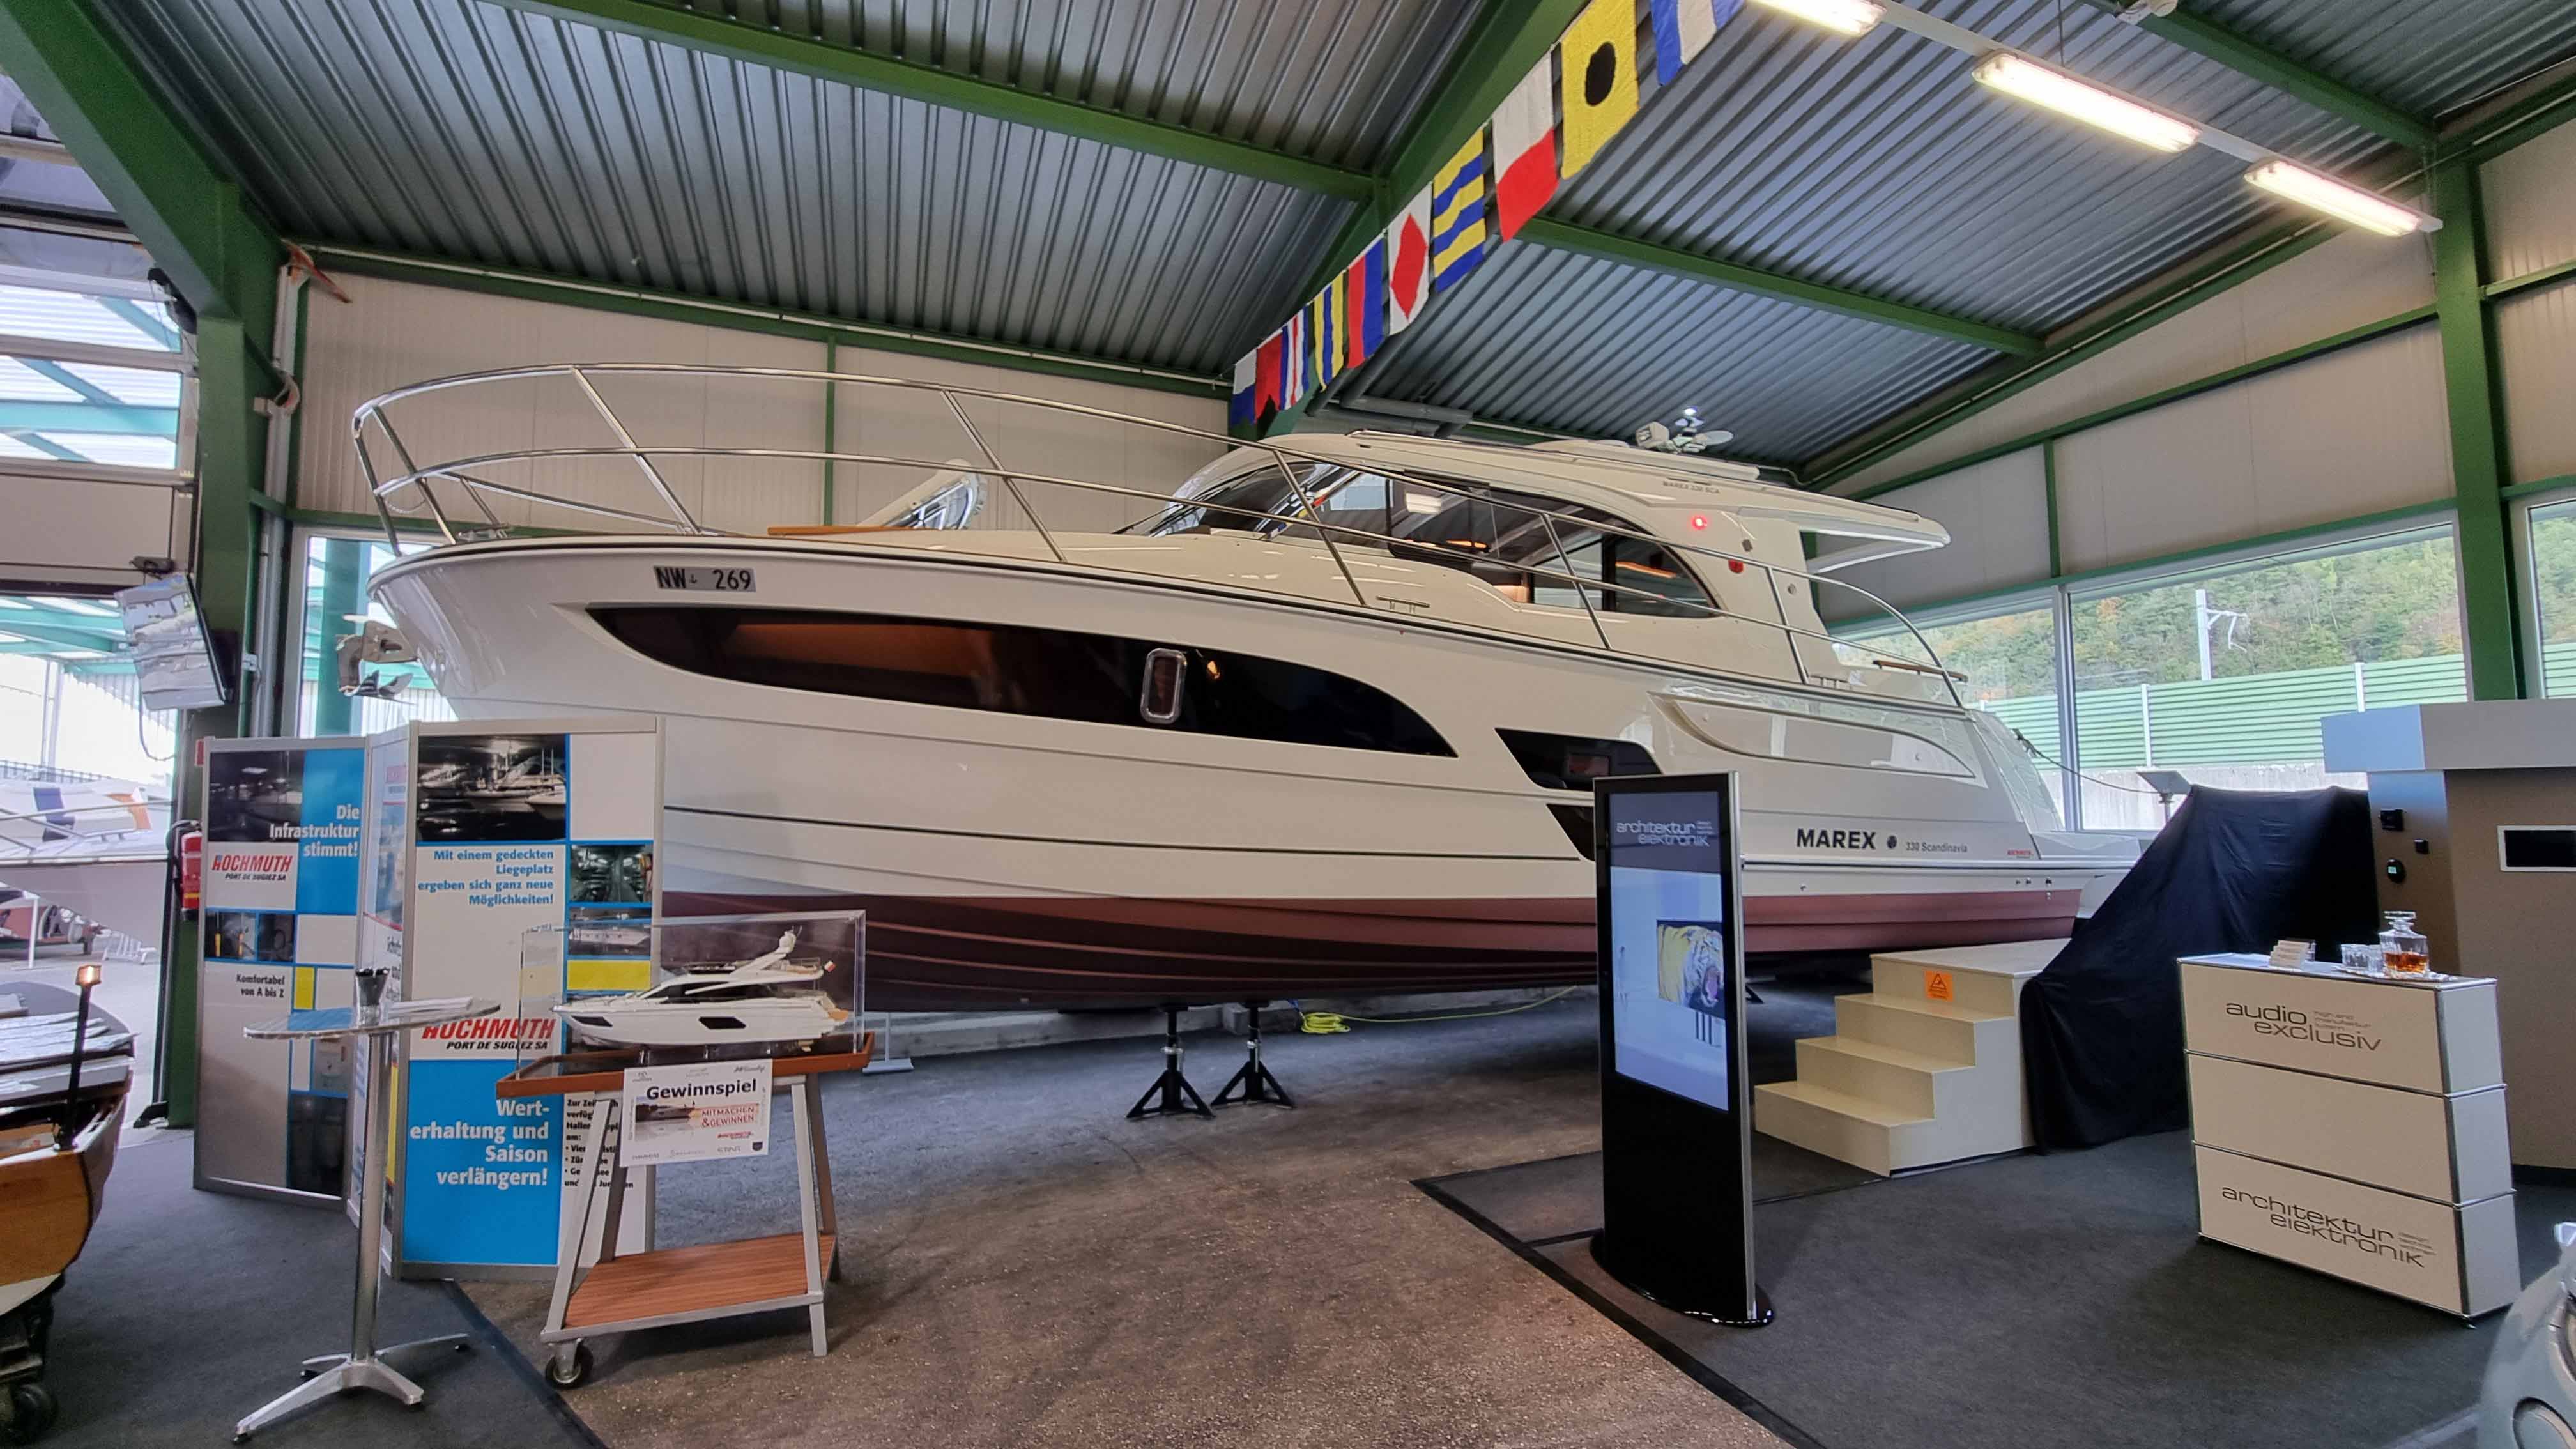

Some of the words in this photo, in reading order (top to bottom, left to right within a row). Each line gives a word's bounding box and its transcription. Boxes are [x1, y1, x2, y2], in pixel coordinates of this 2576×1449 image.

[656, 567, 686, 588] NW
[712, 569, 751, 590] 269
[336, 804, 359, 820] Die
[269, 822, 359, 839] Infrastruktur
[1616, 820, 1696, 834] architektur
[1637, 833, 1710, 847] elektronik
[1797, 828, 1876, 850] MAREX
[1905, 841, 1920, 852] 330
[1921, 841, 1968, 854] Scandinavia
[303, 841, 358, 857] stimmt!
[434, 849, 453, 859] Mit
[457, 850, 492, 859] einem
[496, 849, 554, 862] gedeckten
[211, 854, 293, 872] HOCHMUTH
[496, 864, 554, 877] Liegeplatz
[418, 880, 465, 893] ergeben
[470, 880, 492, 890] sich
[495, 882, 522, 893] ganz
[526, 882, 554, 890] neue
[469, 893, 554, 907] Möglichkeiten!
[236, 974, 286, 986] Komfortabel
[241, 988, 255, 997] von
[257, 988, 263, 997] A
[265, 988, 277, 997] bis
[279, 989, 285, 997] Z
[2225, 1001, 2308, 1025] audio
[421, 1018, 556, 1039] HOCHMUTH
[2253, 1021, 2382, 1052] exclusiv
[447, 1040, 475, 1050] PORT
[477, 1041, 491, 1050] DE
[535, 1041, 548, 1050] SA
[647, 1078, 757, 1100] Gewinnspiel
[496, 1100, 550, 1117] Wert-
[702, 1106, 755, 1117] MITMACHEN
[410, 1121, 506, 1143] erhaltung
[512, 1122, 549, 1139] und
[485, 1144, 548, 1163] Saison
[437, 1167, 548, 1191] verlängern!
[2221, 1186, 2394, 1242] architektur
[2270, 1213, 2425, 1268] elektronik
